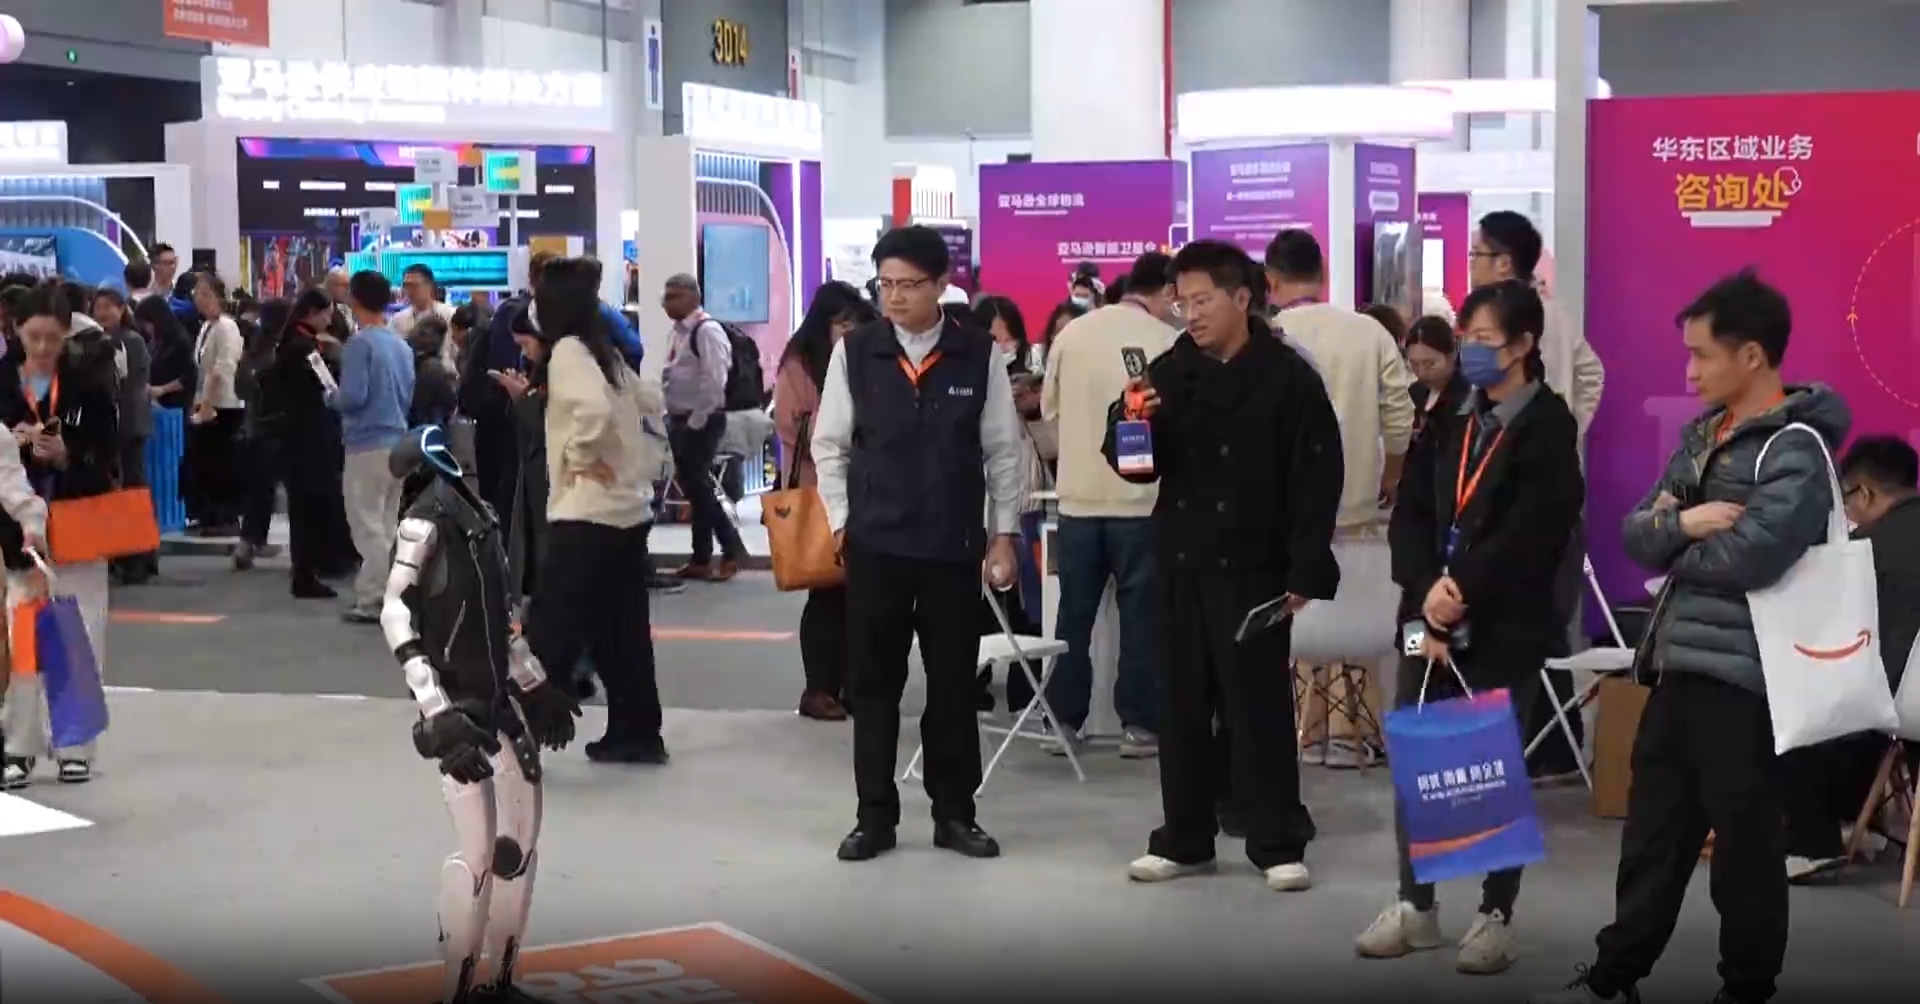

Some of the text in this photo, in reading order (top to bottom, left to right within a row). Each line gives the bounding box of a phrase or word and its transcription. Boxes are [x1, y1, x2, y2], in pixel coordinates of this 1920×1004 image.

[1652, 134, 1814, 162] 华东区域业务
[1674, 172, 1790, 210] 咨询处
